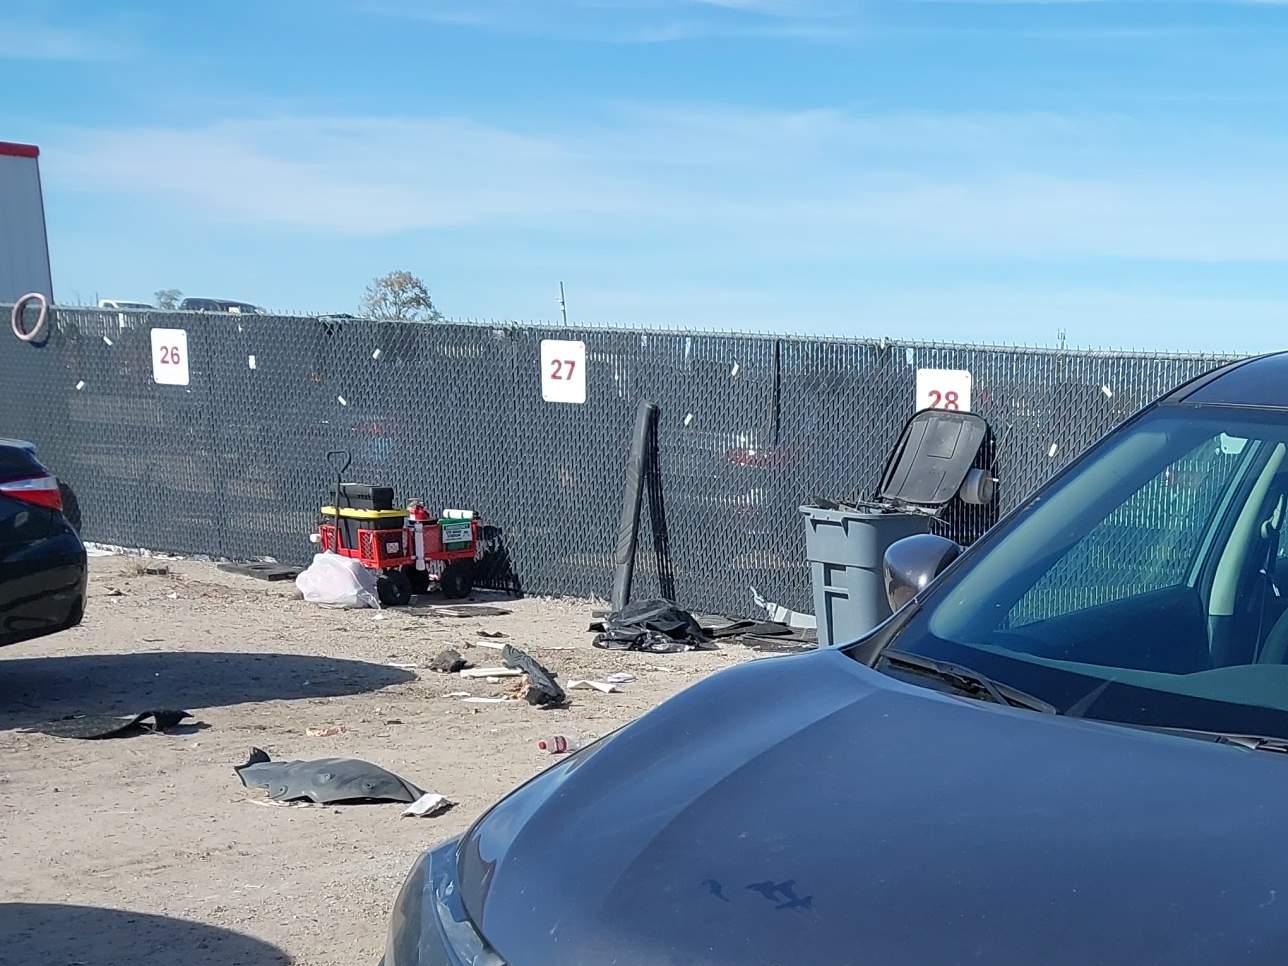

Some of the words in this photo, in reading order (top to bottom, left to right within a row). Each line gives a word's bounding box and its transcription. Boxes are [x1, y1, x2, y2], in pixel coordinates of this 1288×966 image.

[160, 345, 181, 365] 26
[550, 359, 576, 380] 27
[927, 389, 959, 410] 28
